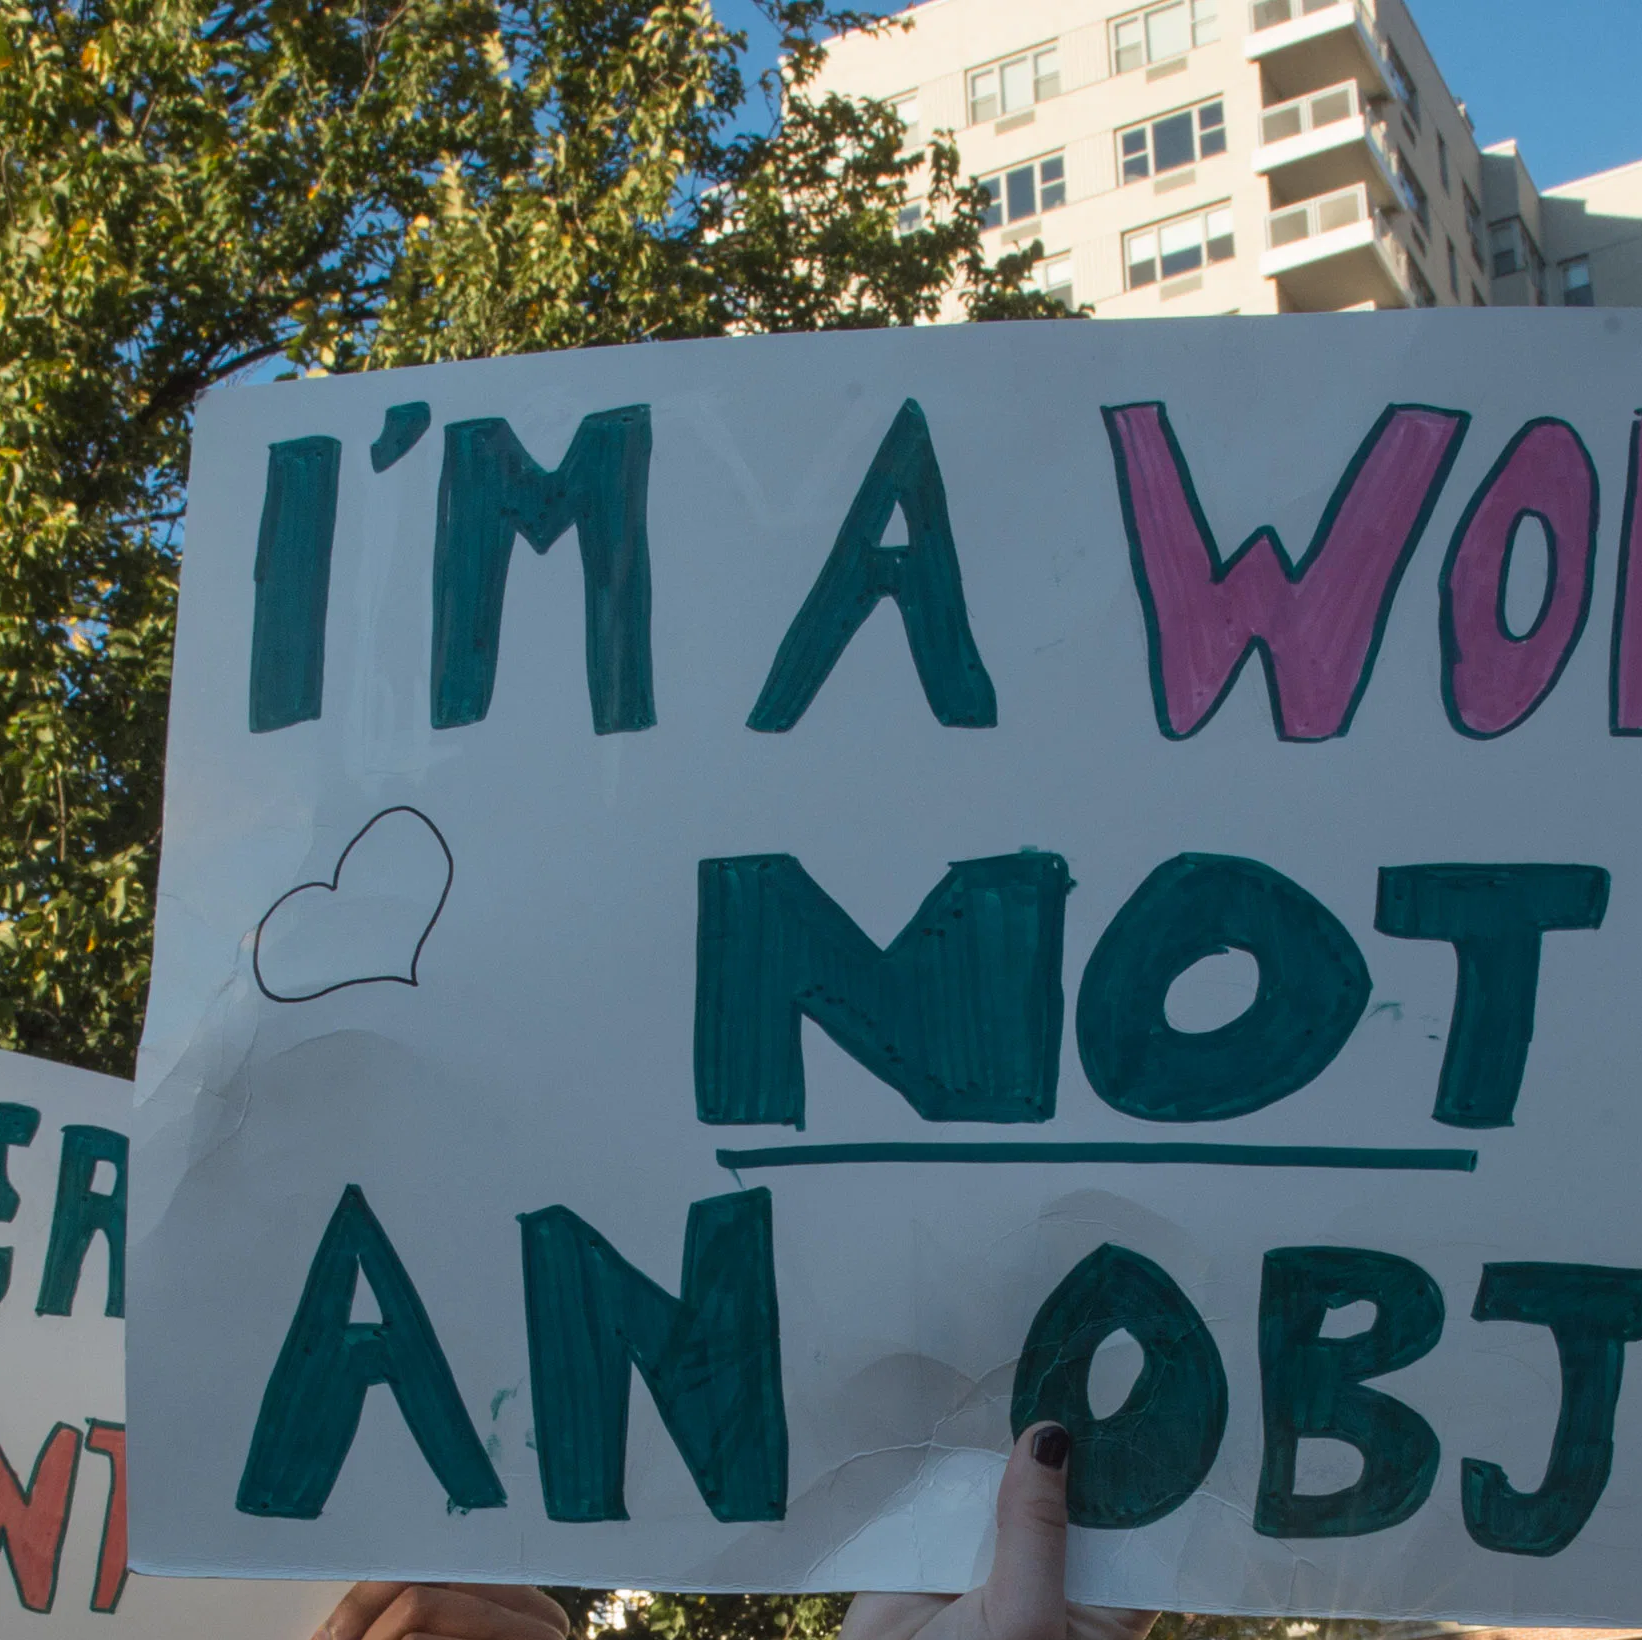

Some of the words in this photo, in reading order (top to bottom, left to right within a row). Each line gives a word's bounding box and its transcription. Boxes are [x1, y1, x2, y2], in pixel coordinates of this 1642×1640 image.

[247, 400, 654, 736] I'M
[745, 397, 1000, 731] A
[692, 847, 1610, 1130] NOT
[235, 1182, 789, 1525] AN
